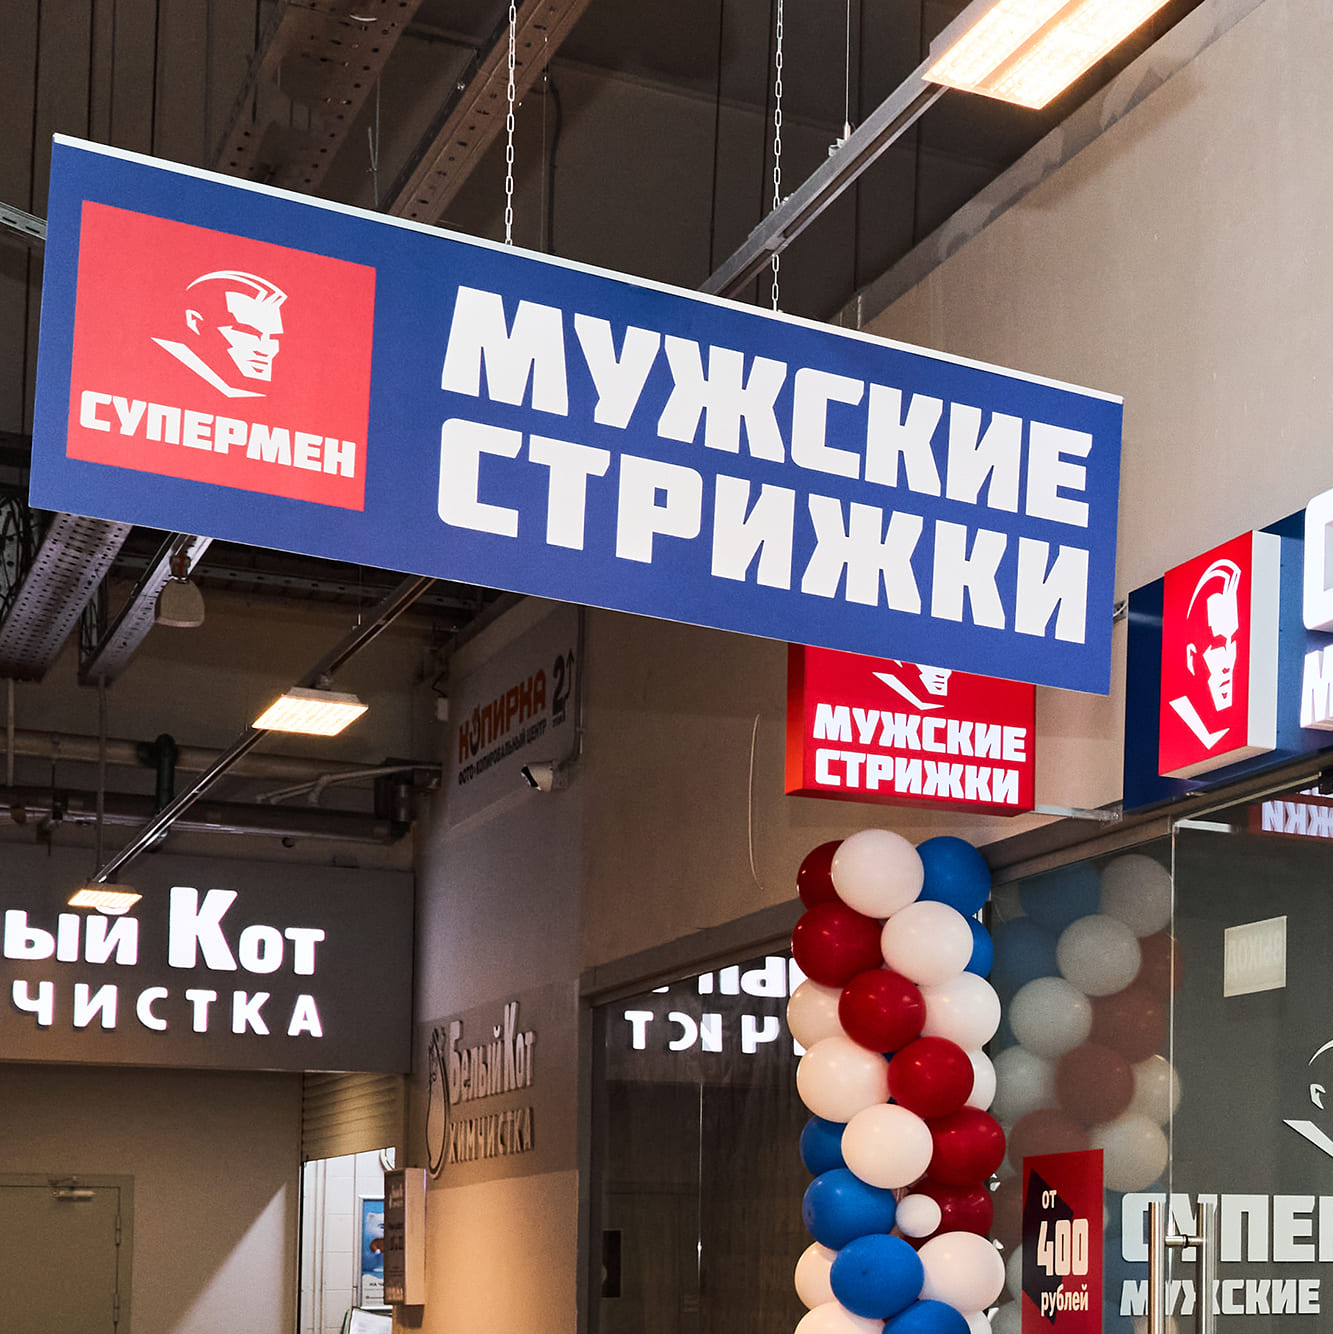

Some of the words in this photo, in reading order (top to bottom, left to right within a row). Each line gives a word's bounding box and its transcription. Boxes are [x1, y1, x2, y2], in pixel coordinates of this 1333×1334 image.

[80, 390, 356, 478] СУПЕРМЕН
[440, 285, 1093, 528] МУЖСКИЕ
[438, 416, 1089, 645] СТРИЖКИ
[813, 703, 1027, 762] МУЖСКИЕ
[815, 748, 1019, 805] СТРИЖКИ
[168, 886, 325, 975] Кот
[12, 980, 323, 1037] ЧИСТКА
[450, 1020, 503, 1104] Белый
[504, 1001, 535, 1092] Кот
[450, 1107, 534, 1163] ХИМЧИСТКА
[1042, 1190, 1057, 1209] от
[1037, 1218, 1088, 1276] 400
[1041, 1284, 1088, 1317] рублей
